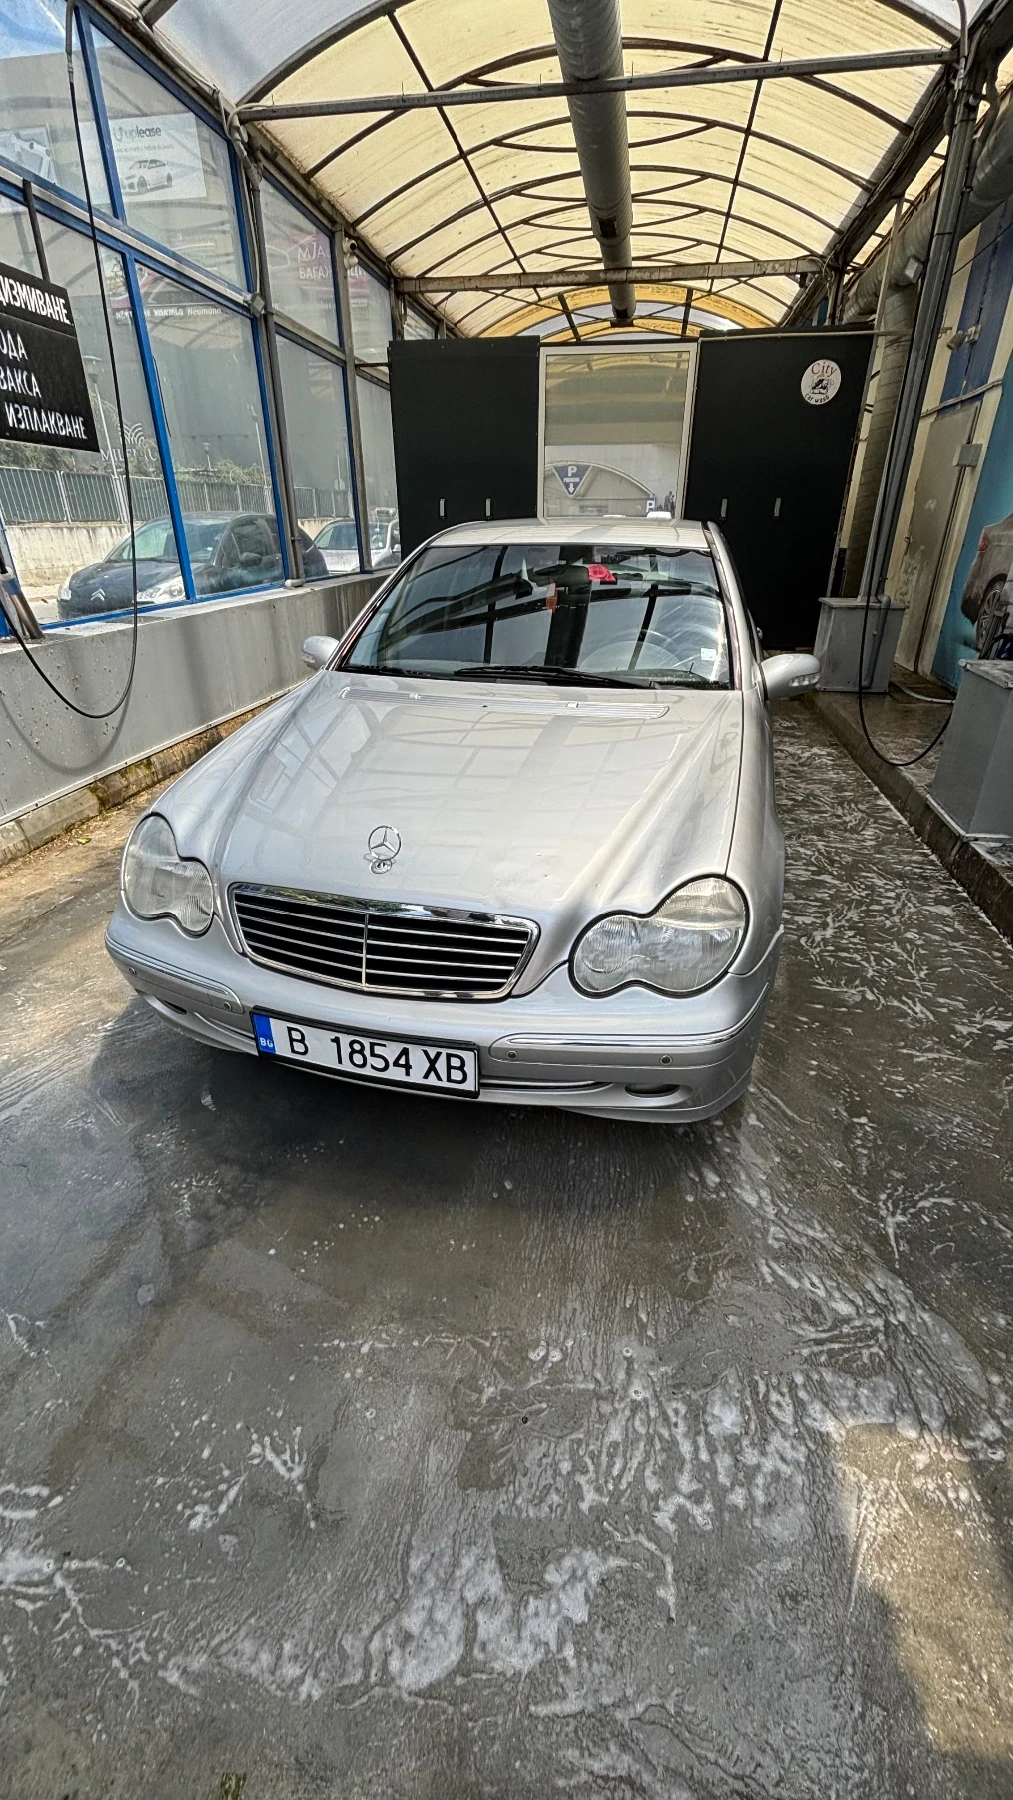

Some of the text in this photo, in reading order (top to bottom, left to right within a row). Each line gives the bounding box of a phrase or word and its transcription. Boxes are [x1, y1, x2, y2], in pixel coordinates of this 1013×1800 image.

[811, 362, 837, 378] City
[5, 401, 88, 439] ИЗПЛАКВАНЕ
[567, 465, 578, 477] P
[260, 1037, 274, 1049] BG
[287, 1025, 468, 1085] B 1854 XB
